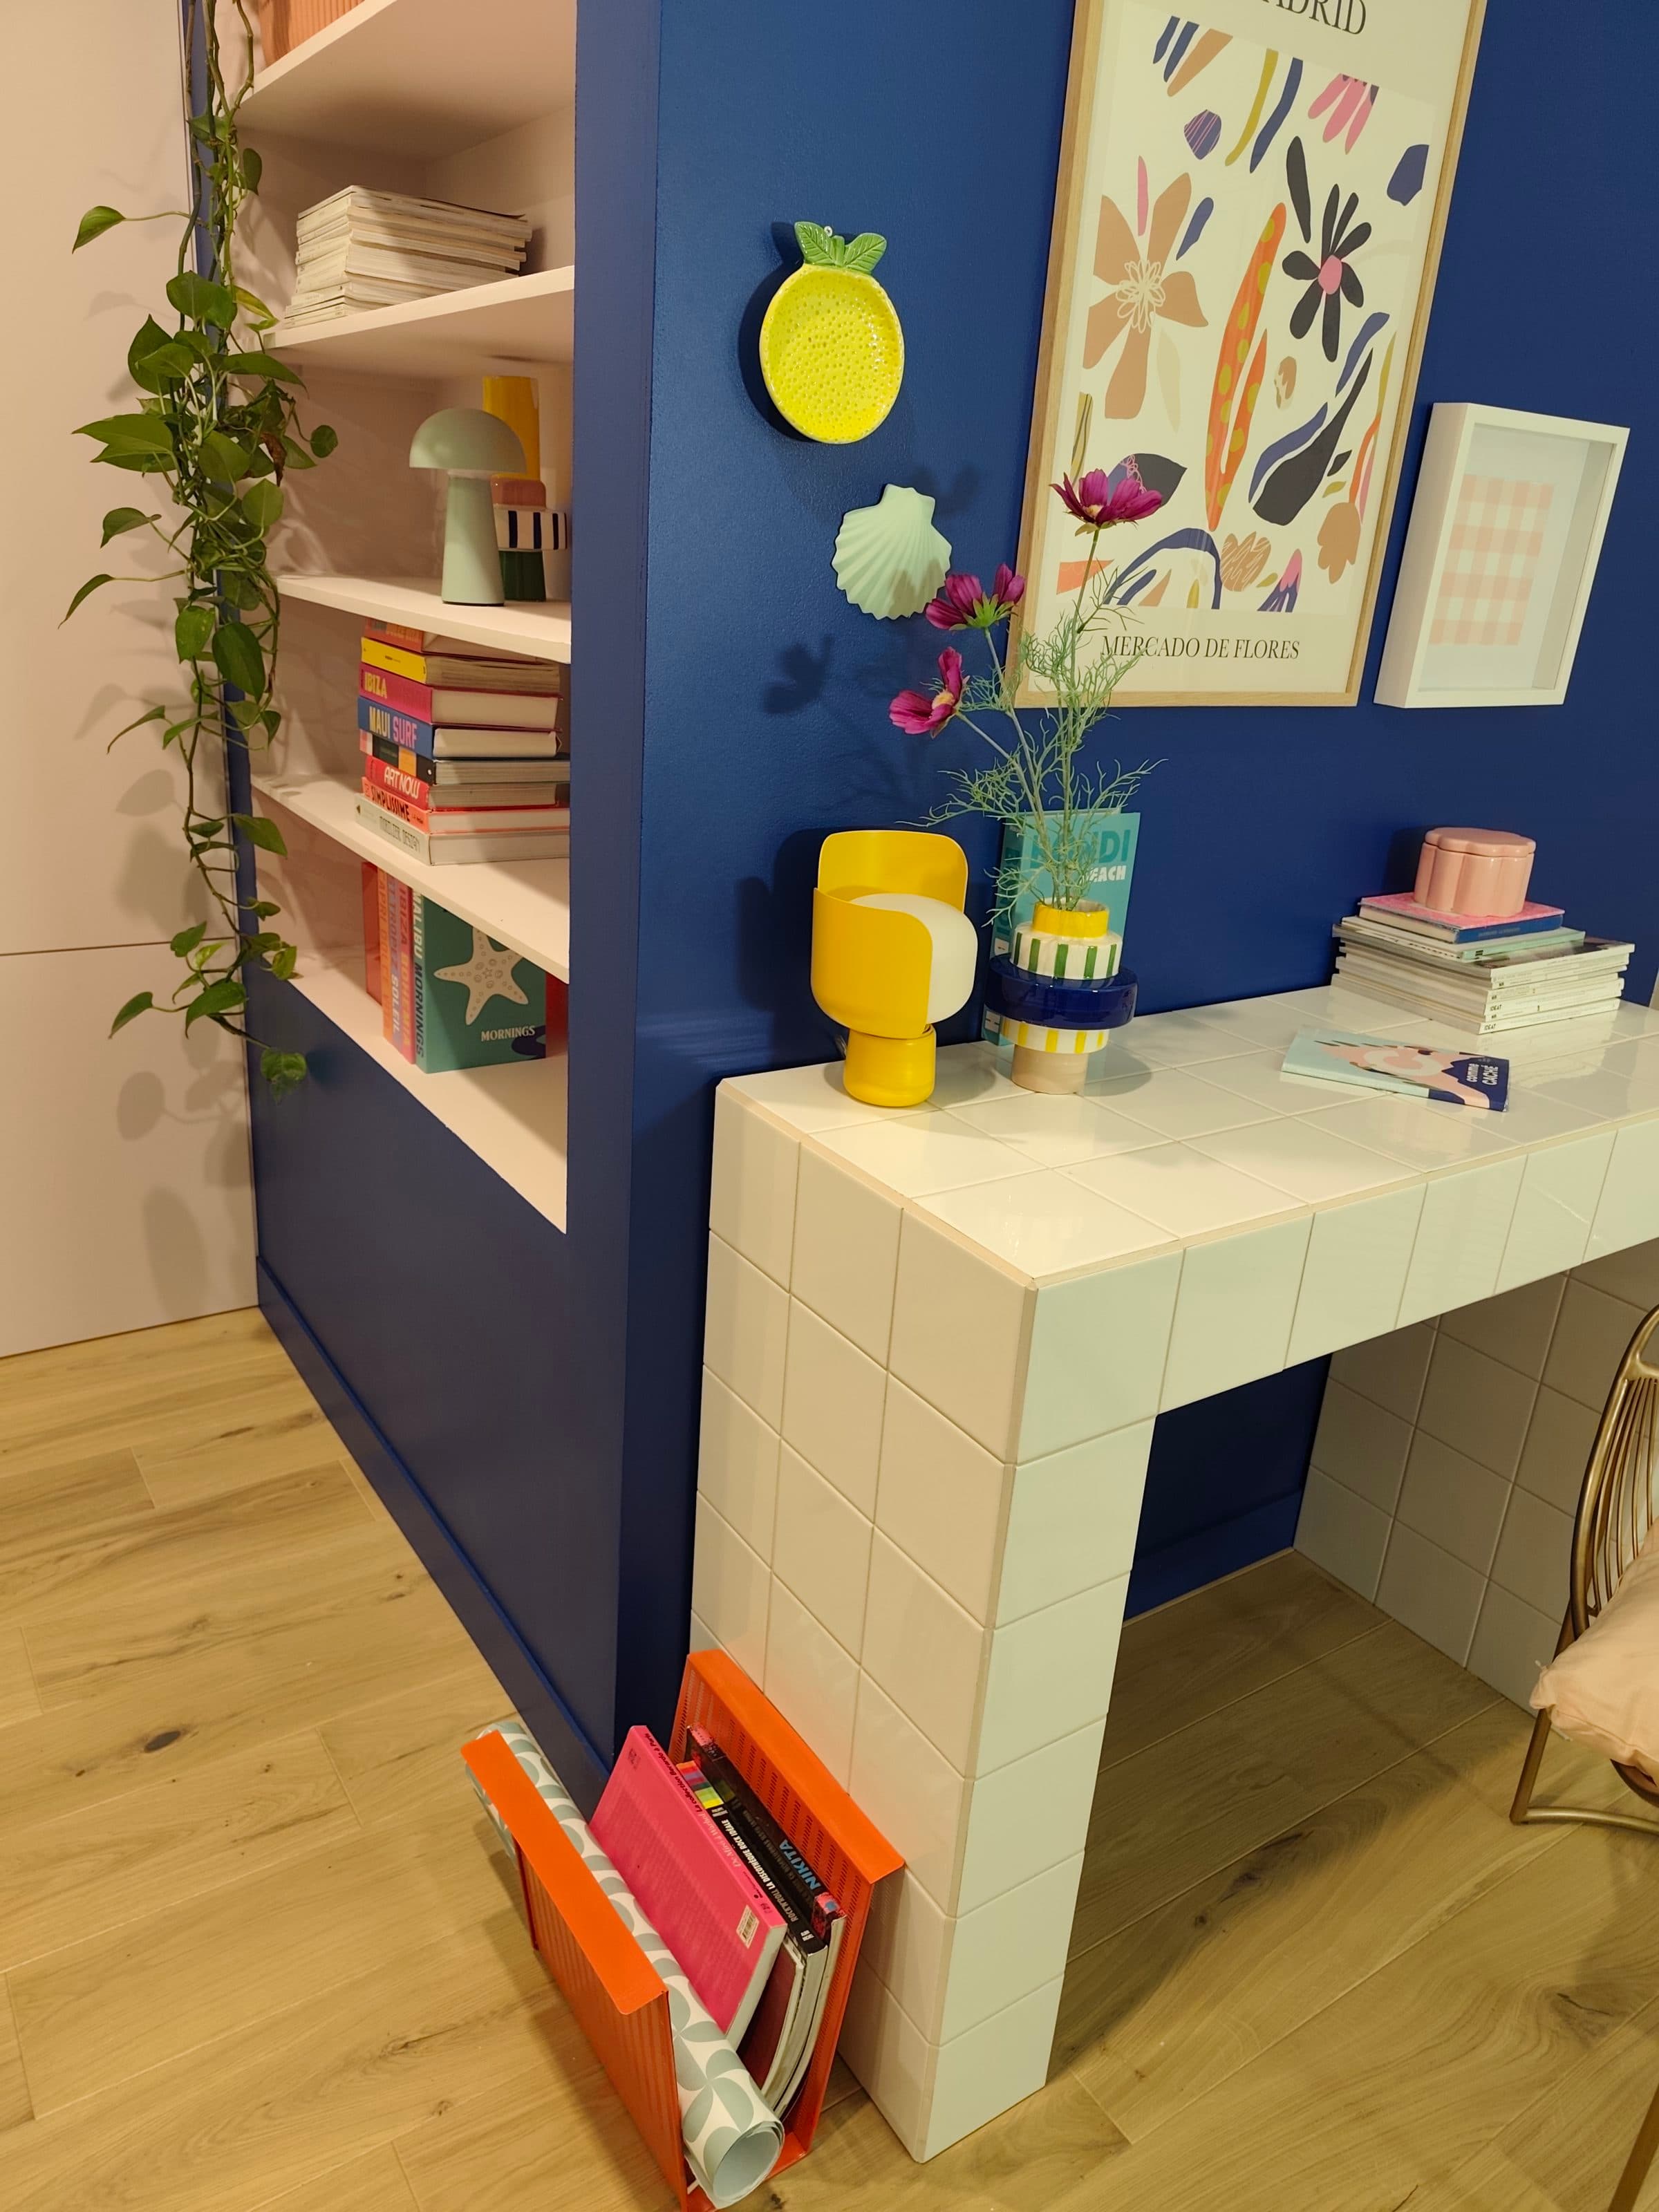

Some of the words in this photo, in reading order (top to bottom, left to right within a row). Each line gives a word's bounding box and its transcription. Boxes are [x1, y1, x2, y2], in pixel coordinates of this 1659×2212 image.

[1101, 635, 1200, 658] MERCADO
[1205, 638, 1230, 658] DE
[1233, 639, 1300, 659] FLORES
[364, 671, 388, 699] IBIZA
[368, 705, 391, 740] MAUI
[393, 715, 418, 749] SURF
[384, 766, 400, 789] ART
[399, 774, 421, 799] NOW
[371, 785, 411, 822] SIMPLISSIME
[1078, 865, 1127, 884] EACH
[399, 887, 408, 944] IBIZA
[391, 974, 400, 1033] SOLEIL
[414, 962, 424, 1058] MORNINGS
[480, 1025, 536, 1042] MORNINGS
[658, 1752, 677, 1776] Berardo
[675, 1776, 697, 1804] collection
[721, 1819, 739, 1838] IDÉALE
[734, 1835, 748, 1850] ROCK
[742, 1848, 772, 1885] DISCOTHÈQUE
[778, 1838, 821, 1890] NIKITA
